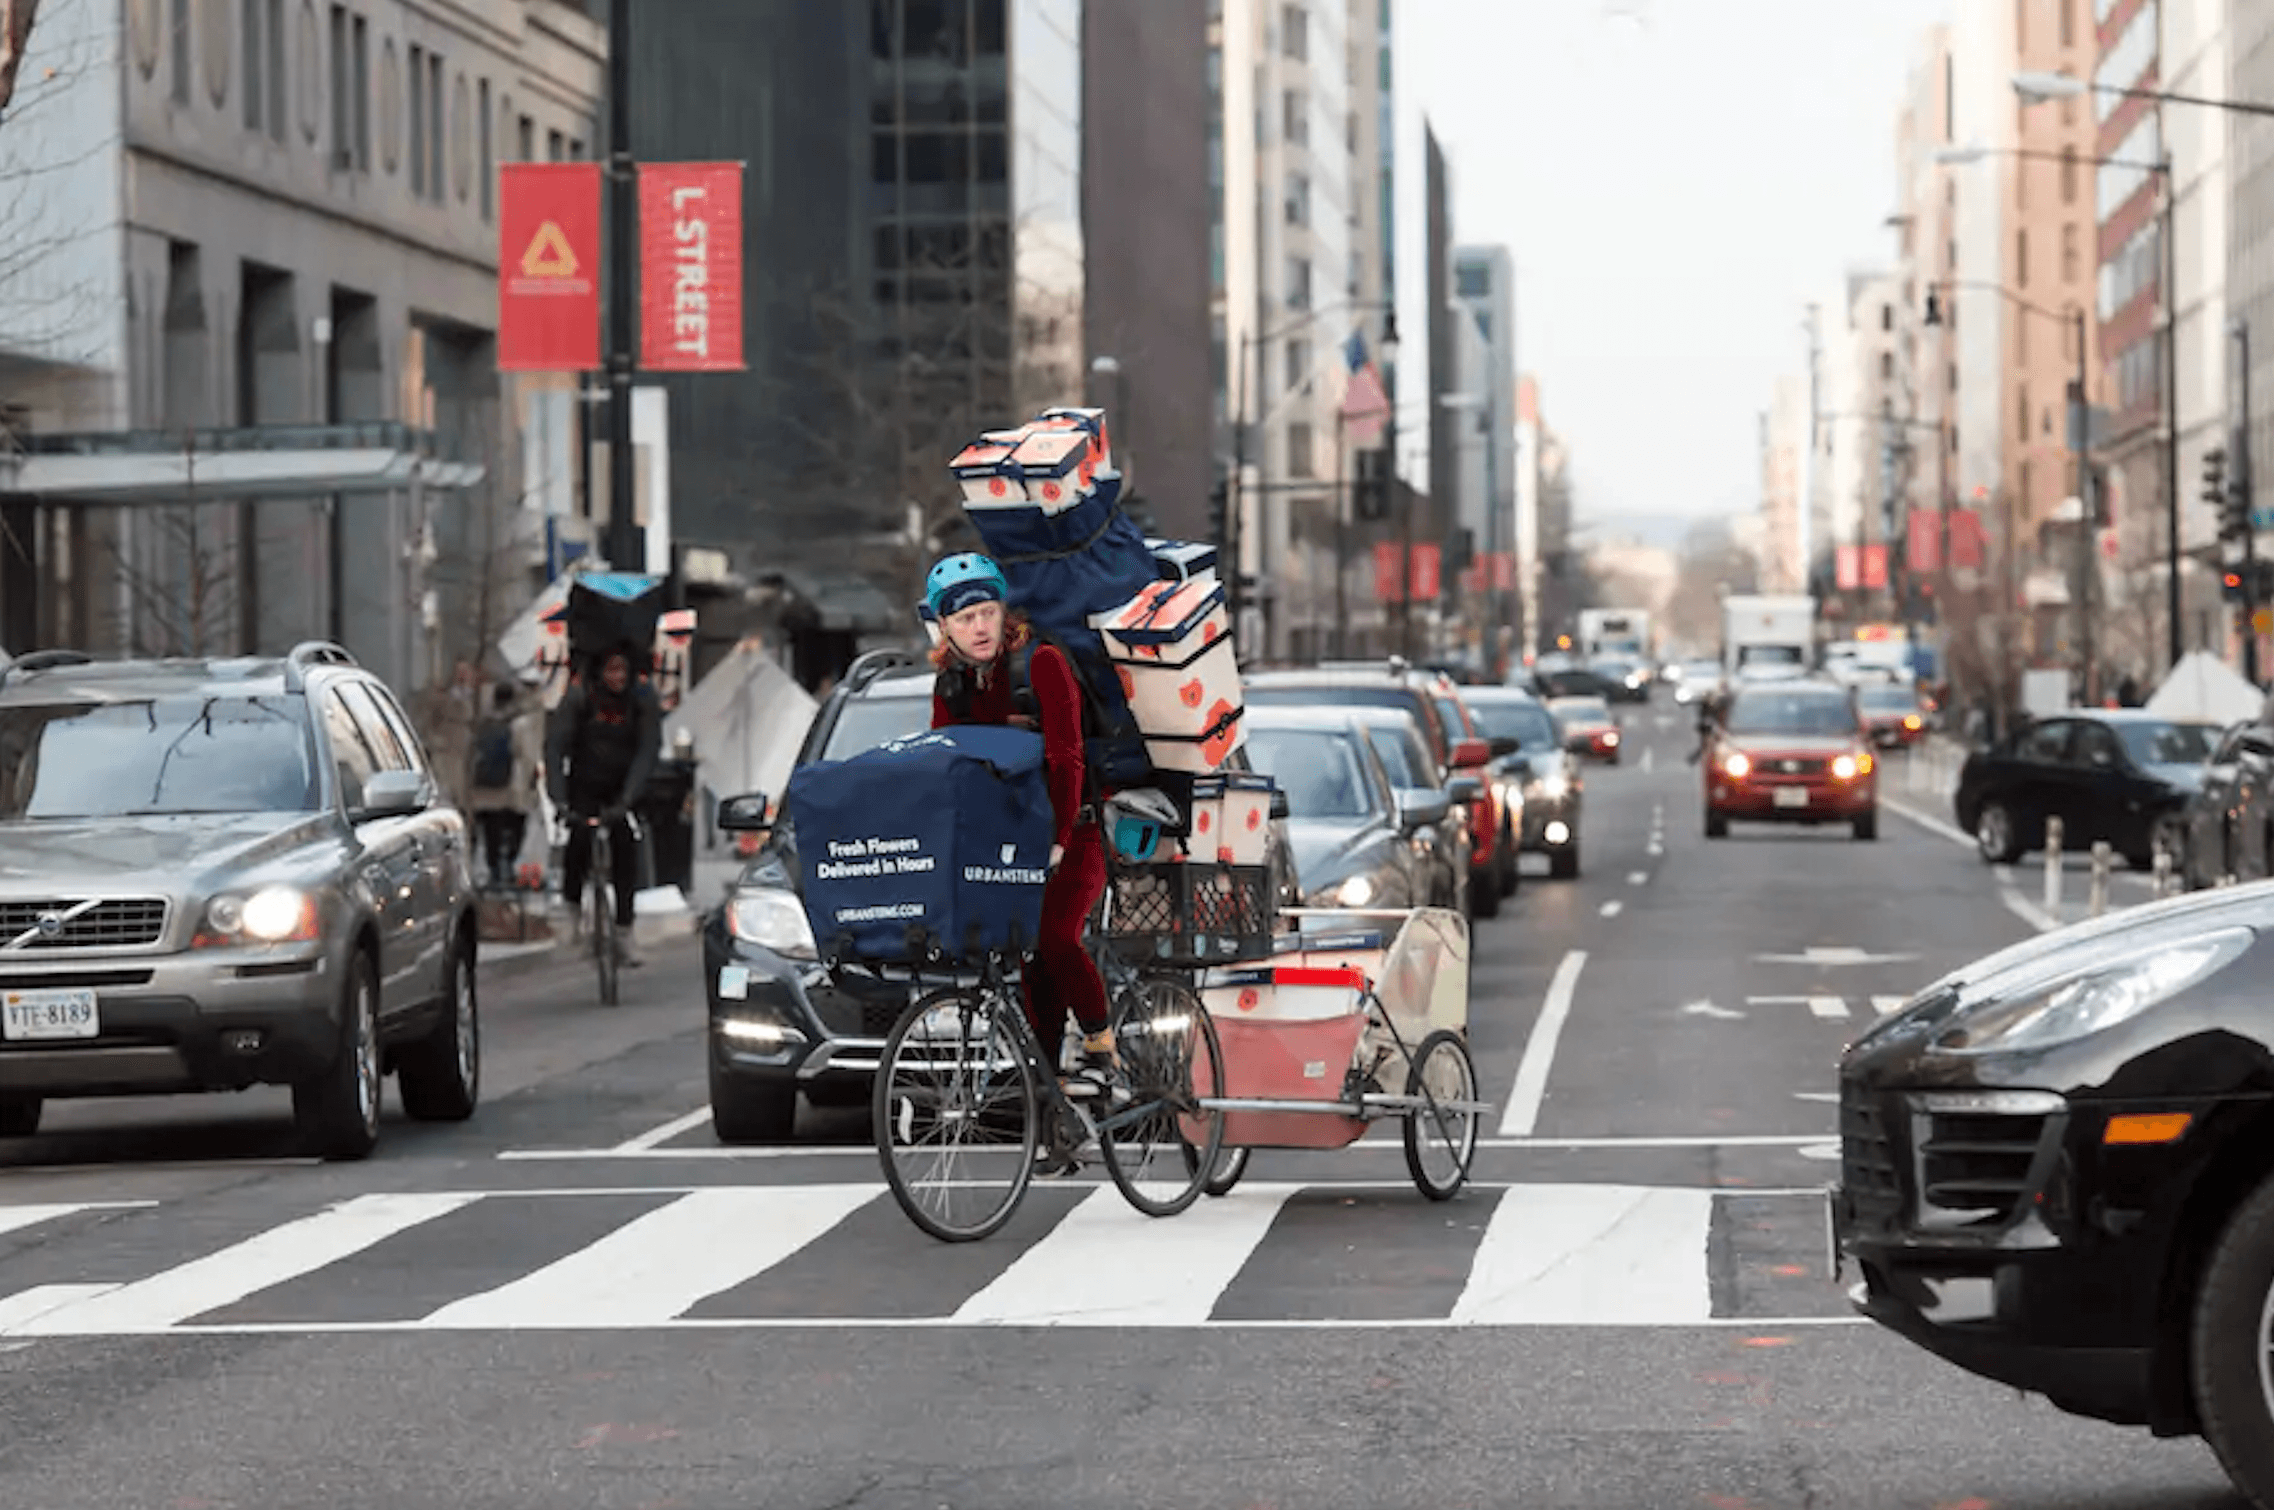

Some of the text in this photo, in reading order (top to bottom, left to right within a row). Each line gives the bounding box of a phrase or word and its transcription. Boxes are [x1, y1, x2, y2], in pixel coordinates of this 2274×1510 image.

[674, 187, 707, 356] L STREET
[828, 837, 919, 857] Fresh Flowers
[817, 855, 935, 879] Delivered in Hours
